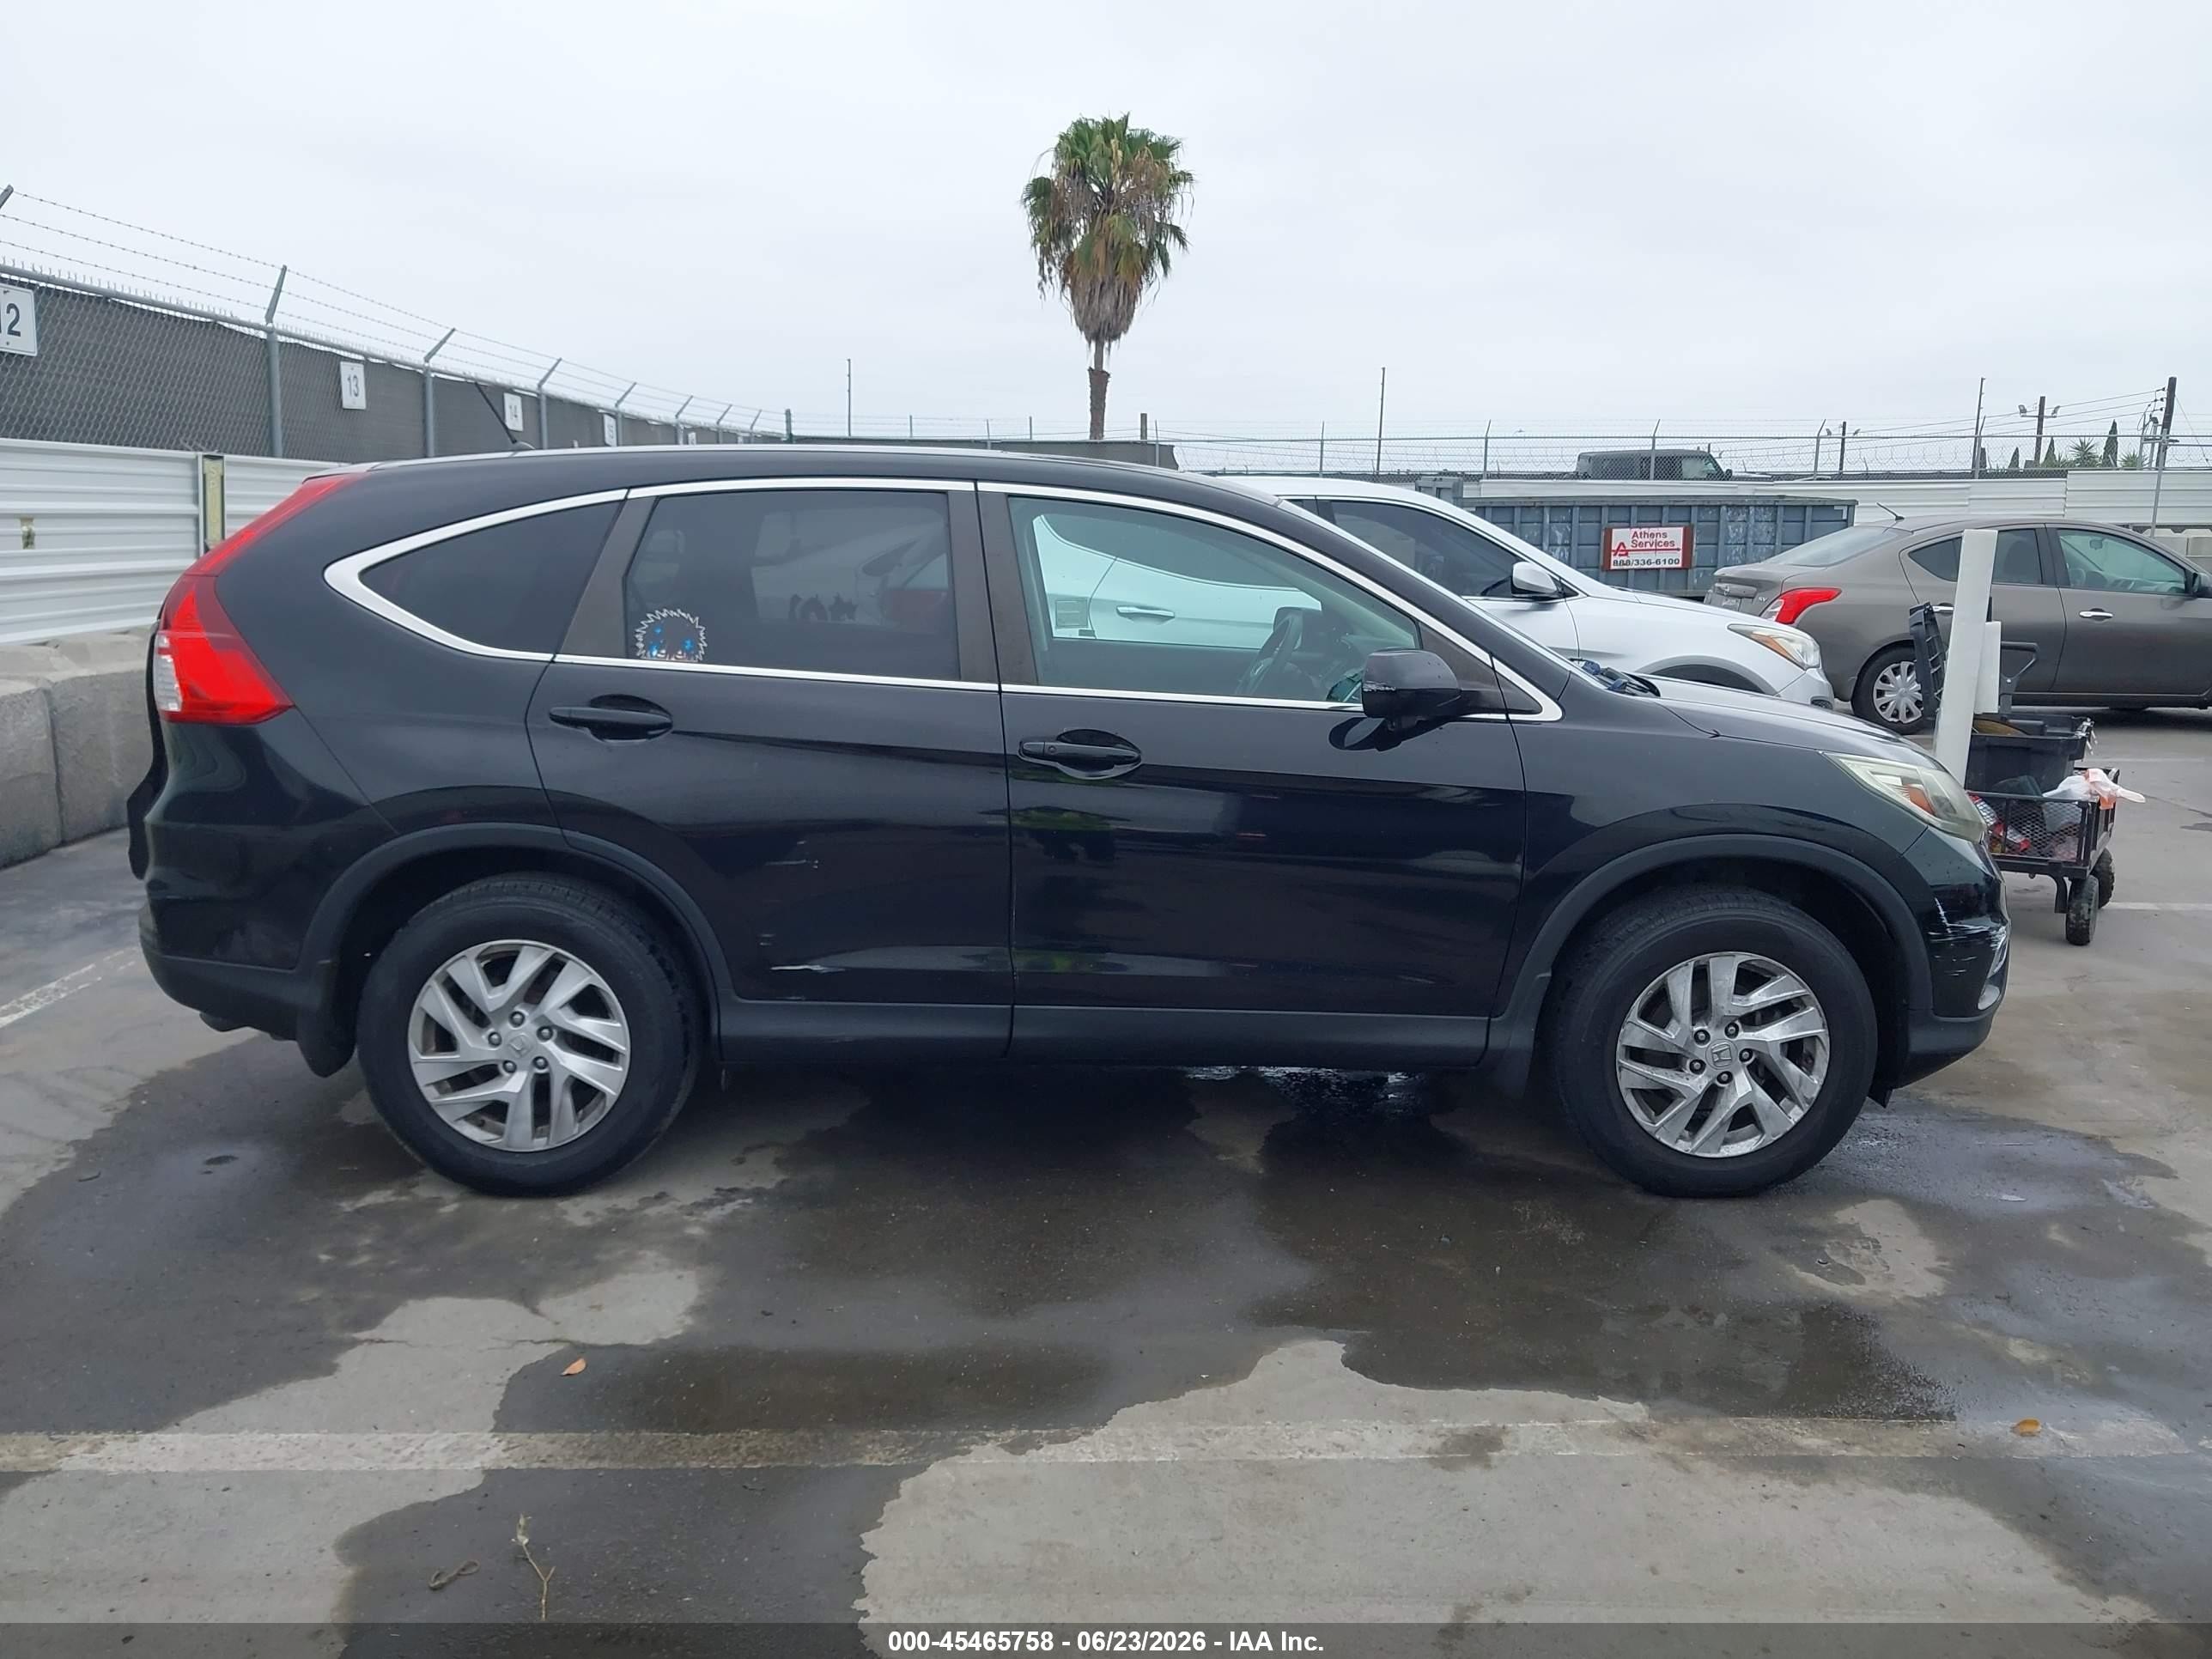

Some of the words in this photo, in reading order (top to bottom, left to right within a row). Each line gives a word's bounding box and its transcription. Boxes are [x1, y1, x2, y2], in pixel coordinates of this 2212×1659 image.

[347, 374, 359, 397] 13
[1632, 531, 1668, 539] Athens
[1630, 539, 1675, 548] Services
[1613, 557, 1680, 567] 888/336-6100
